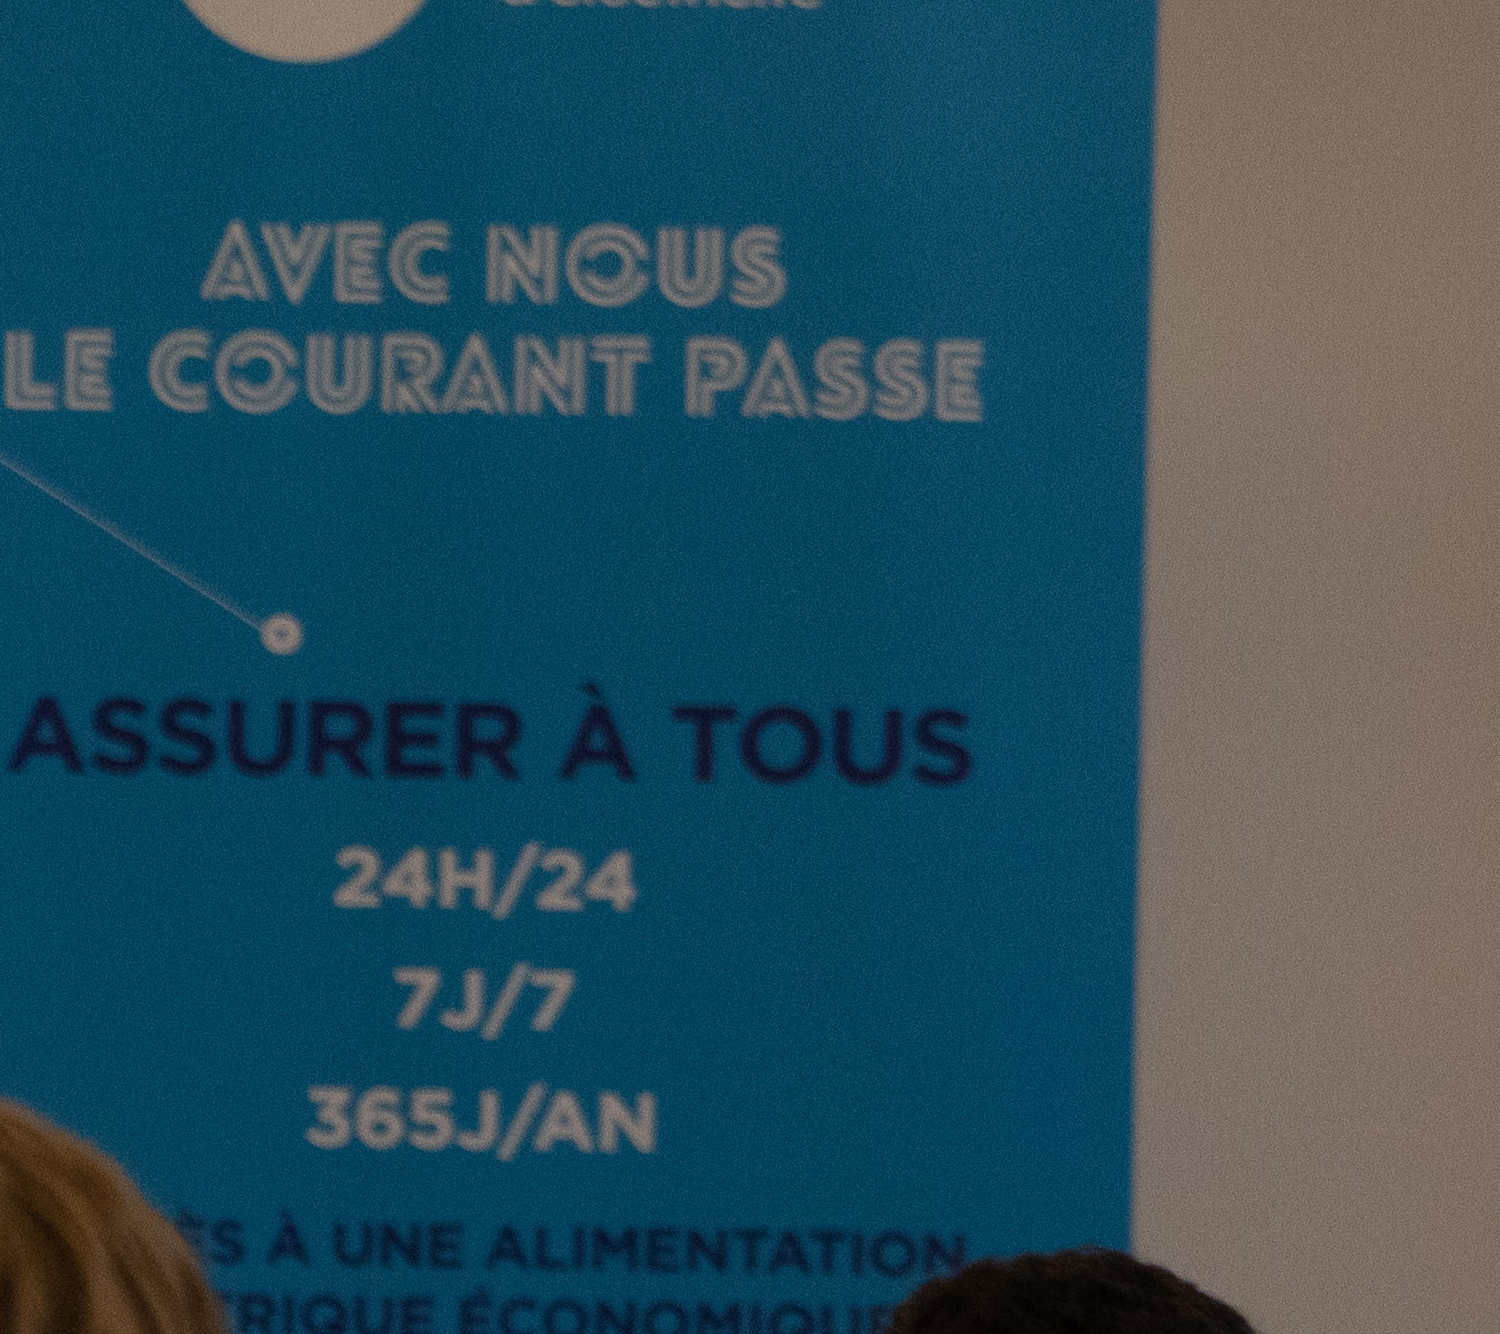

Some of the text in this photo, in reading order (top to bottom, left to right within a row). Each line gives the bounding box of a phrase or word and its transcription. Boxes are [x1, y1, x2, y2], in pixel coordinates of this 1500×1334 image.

[200, 219, 789, 309] AVEC NOUS
[2, 328, 988, 424] LE COURANT PASSE
[7, 683, 976, 787] ASSURER À TOUS
[332, 841, 639, 920] 24H/24
[393, 962, 577, 1041] 7J/7
[304, 1081, 658, 1162] 365J/AN
[269, 1209, 308, 1264] À
[331, 1219, 463, 1269] UNE
[489, 1223, 968, 1279] ALIMENTATION
